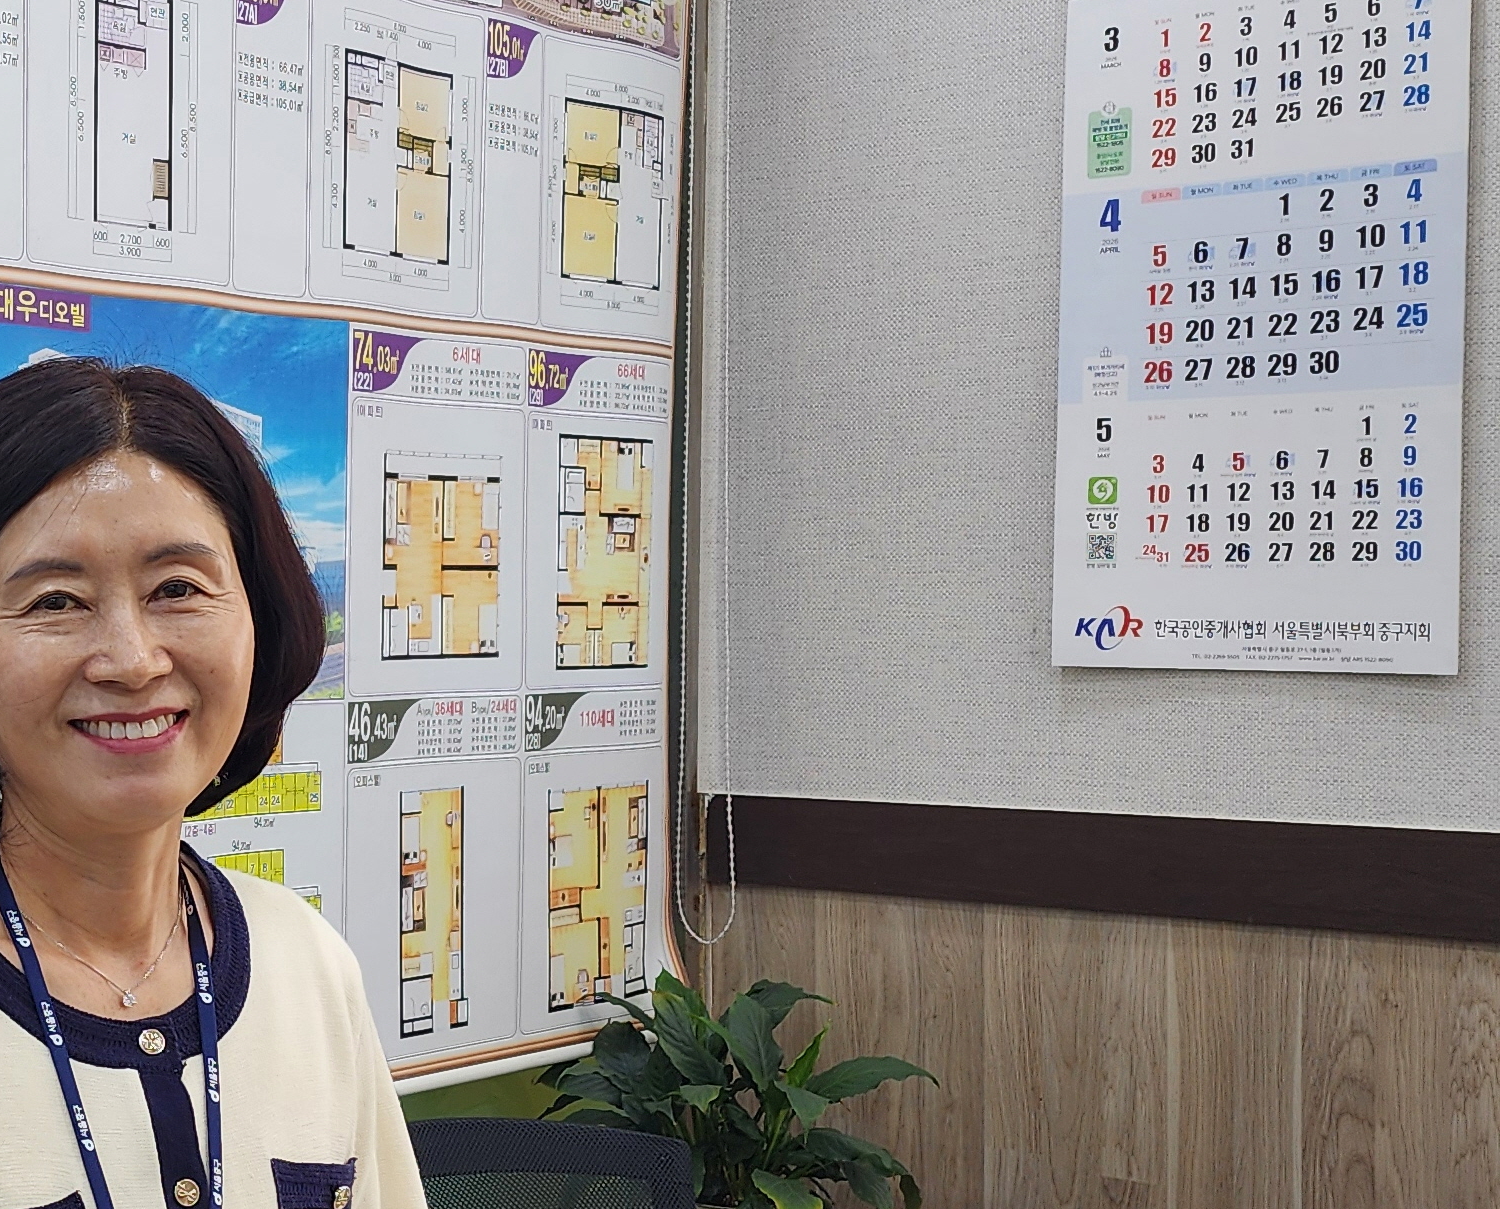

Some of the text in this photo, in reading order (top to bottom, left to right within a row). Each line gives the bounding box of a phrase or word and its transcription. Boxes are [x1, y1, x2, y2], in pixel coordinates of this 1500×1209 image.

[1104, 27, 1119, 52] 3
[1279, 179, 1422, 216] 1 2 3 4
[1100, 199, 1121, 232] 4
[1154, 220, 1426, 266] 5 6 7 8 9 10 11
[1147, 261, 1428, 305] 12 13 14 15 16 17 18
[1146, 303, 1427, 344] 19 20 21 22 23 24 25
[453, 347, 481, 364] 6세대
[1144, 361, 1172, 383] 26
[1185, 358, 1212, 381] 27
[1226, 356, 1255, 379] 28
[1268, 353, 1297, 377] 29
[1310, 351, 1339, 374] 30
[617, 363, 645, 380] 66세대
[1097, 418, 1111, 442] 5
[1147, 478, 1423, 503] 10 11 12 13 14 15 16
[1085, 512, 1119, 530] 한방
[1146, 509, 1422, 533] 17 18 19 20 21 22 23
[1185, 541, 1421, 562] 25 26 27 28 29 30
[1075, 605, 1431, 651] KAR 한국공인중개사협회 서울특별시북부회 중구지회
[580, 708, 615, 727] 110세대
